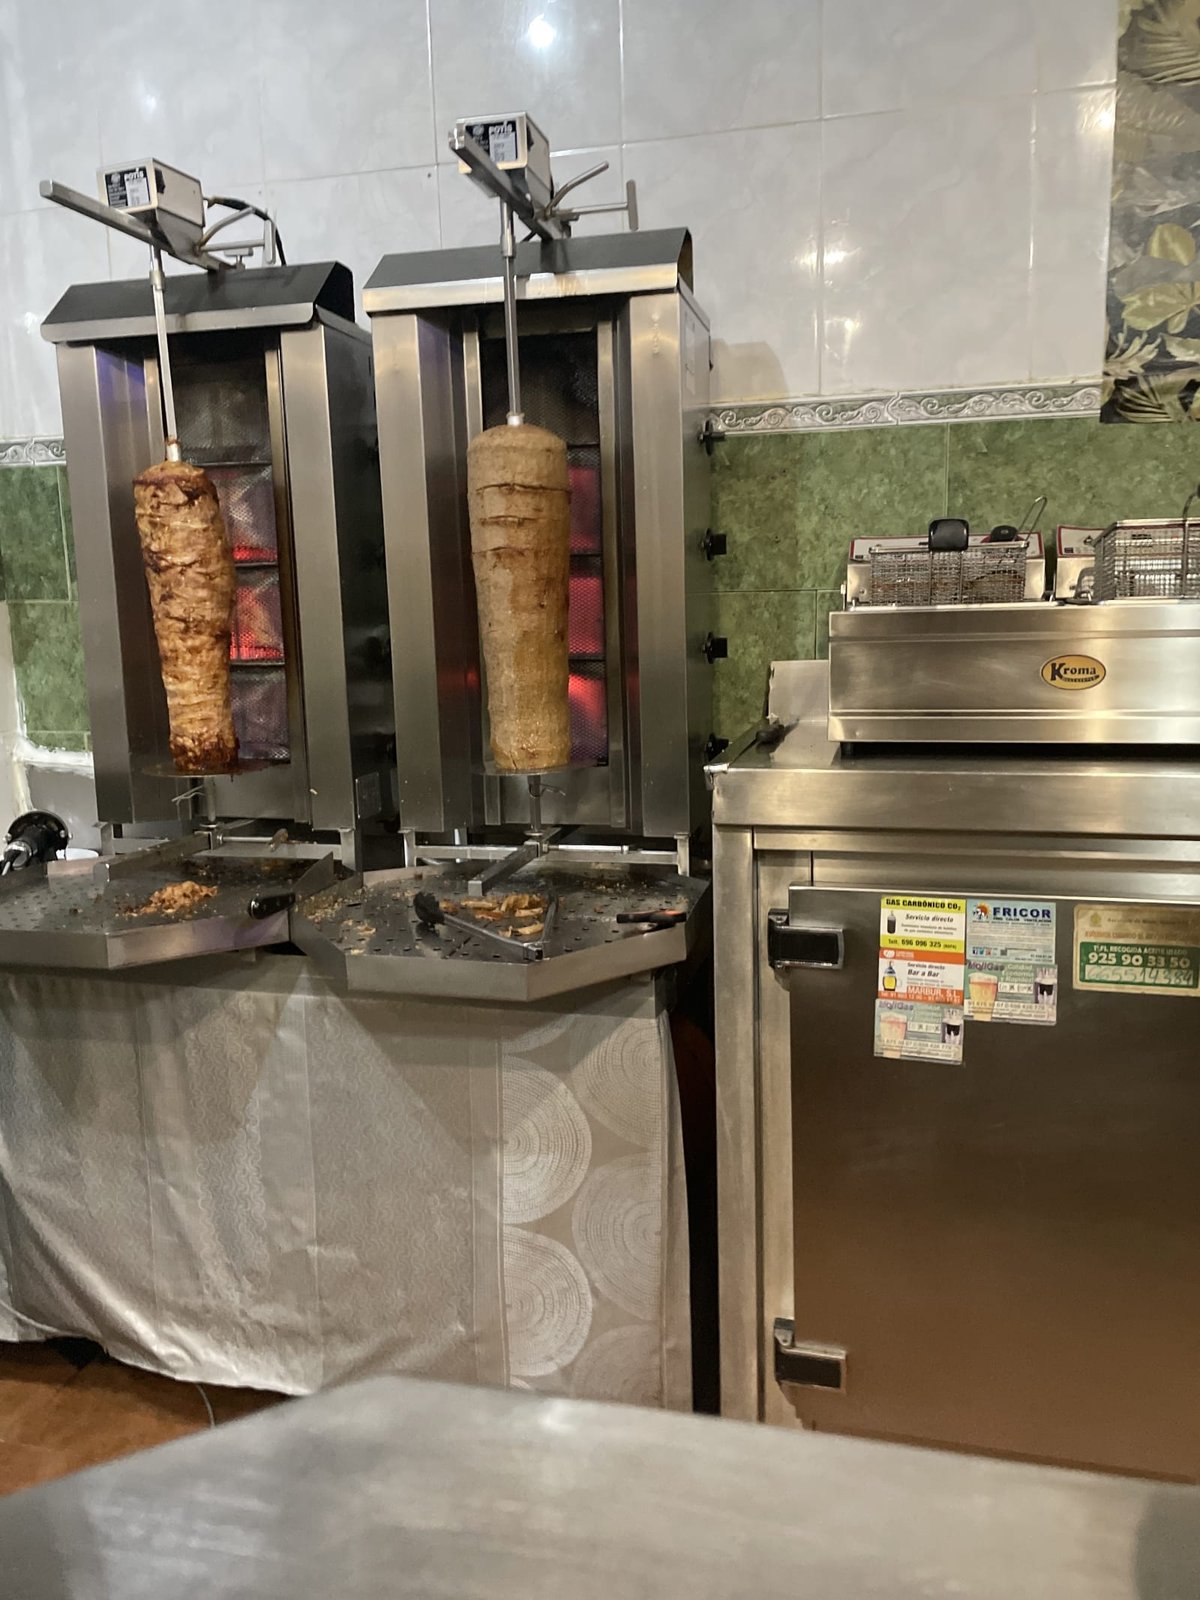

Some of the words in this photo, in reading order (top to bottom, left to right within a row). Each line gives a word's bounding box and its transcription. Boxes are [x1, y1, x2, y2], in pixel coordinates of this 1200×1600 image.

[1050, 662, 1097, 681] Kroma
[905, 913, 930, 921] Servicio
[931, 915, 954, 923] directo
[993, 907, 1051, 919] FRICOR
[929, 940, 942, 948] 325
[1110, 946, 1142, 954] RECOGIDA
[1088, 952, 1117, 965] 925
[1121, 954, 1143, 966] 90
[1147, 955, 1165, 968] 33
[1170, 957, 1191, 968] 50
